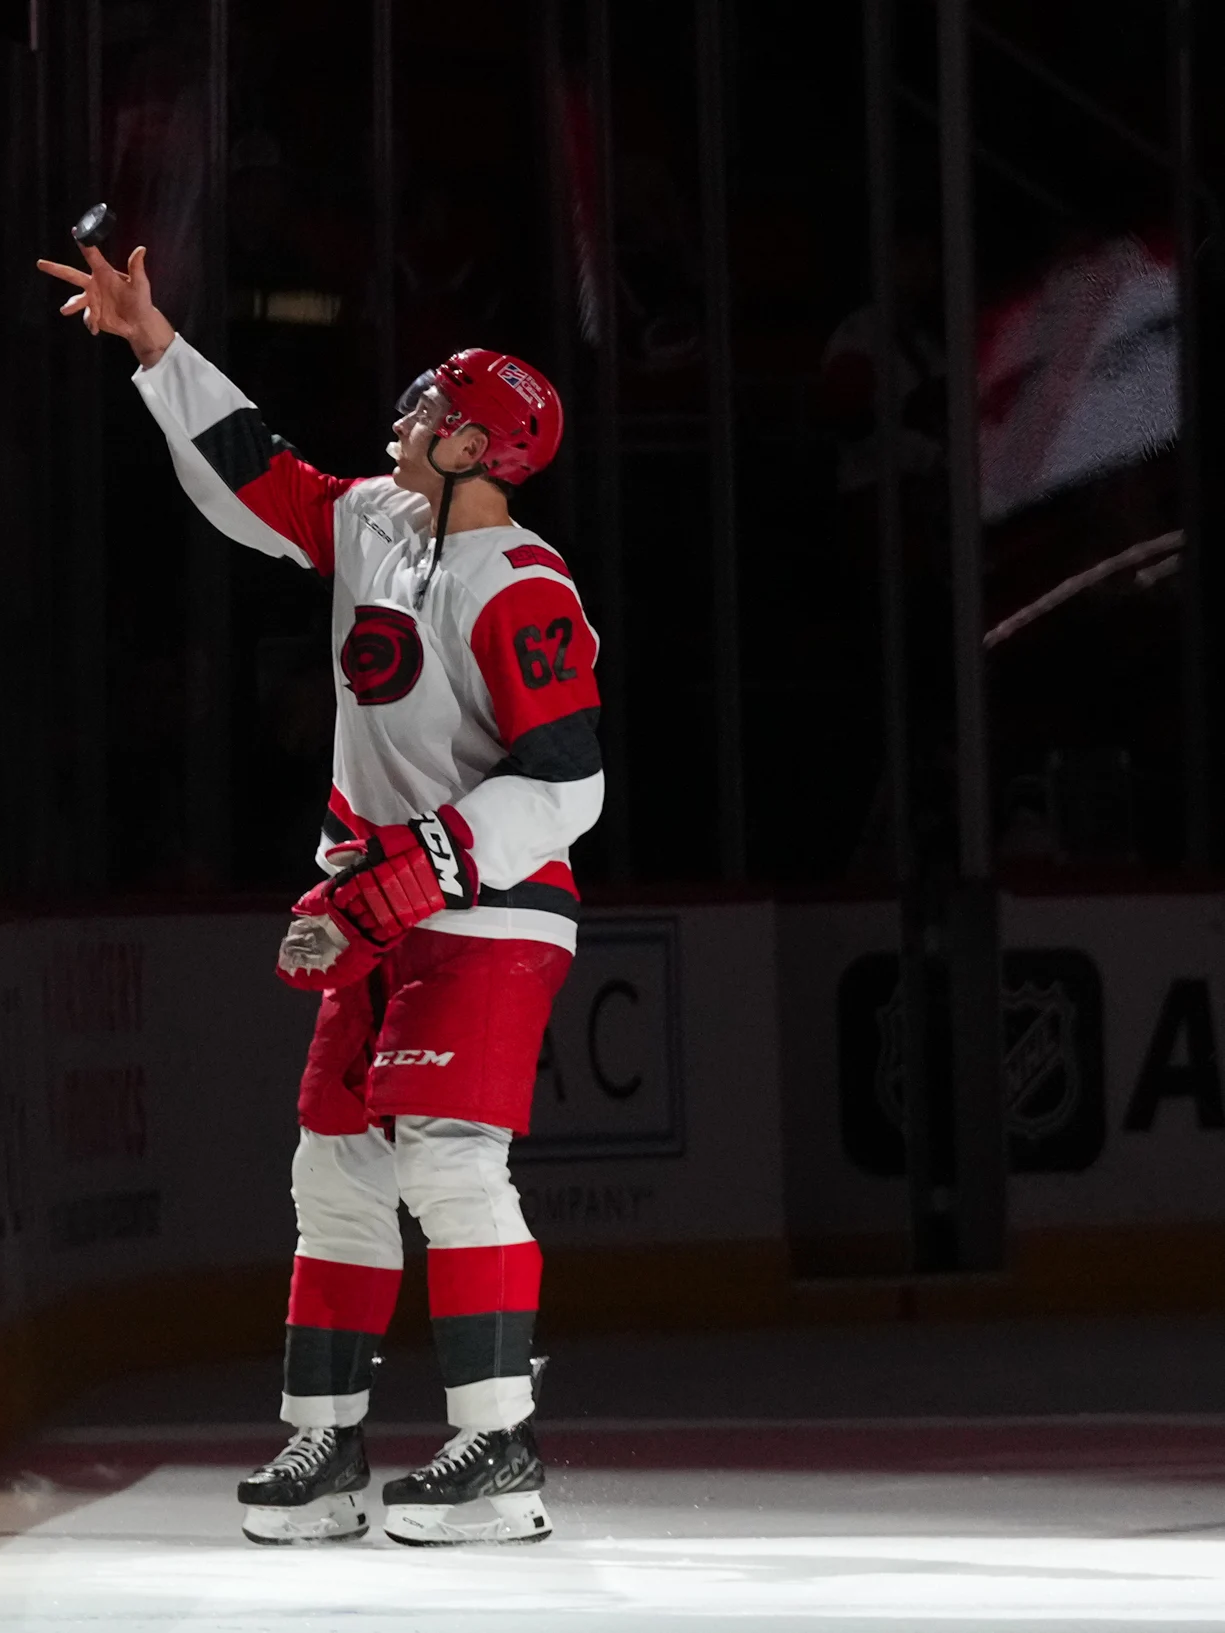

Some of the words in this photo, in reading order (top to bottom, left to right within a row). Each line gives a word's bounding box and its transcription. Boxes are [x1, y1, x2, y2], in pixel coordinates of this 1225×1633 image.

[514, 617, 579, 691] 62
[374, 1050, 455, 1068] CCM
[1124, 978, 1225, 1130] A
